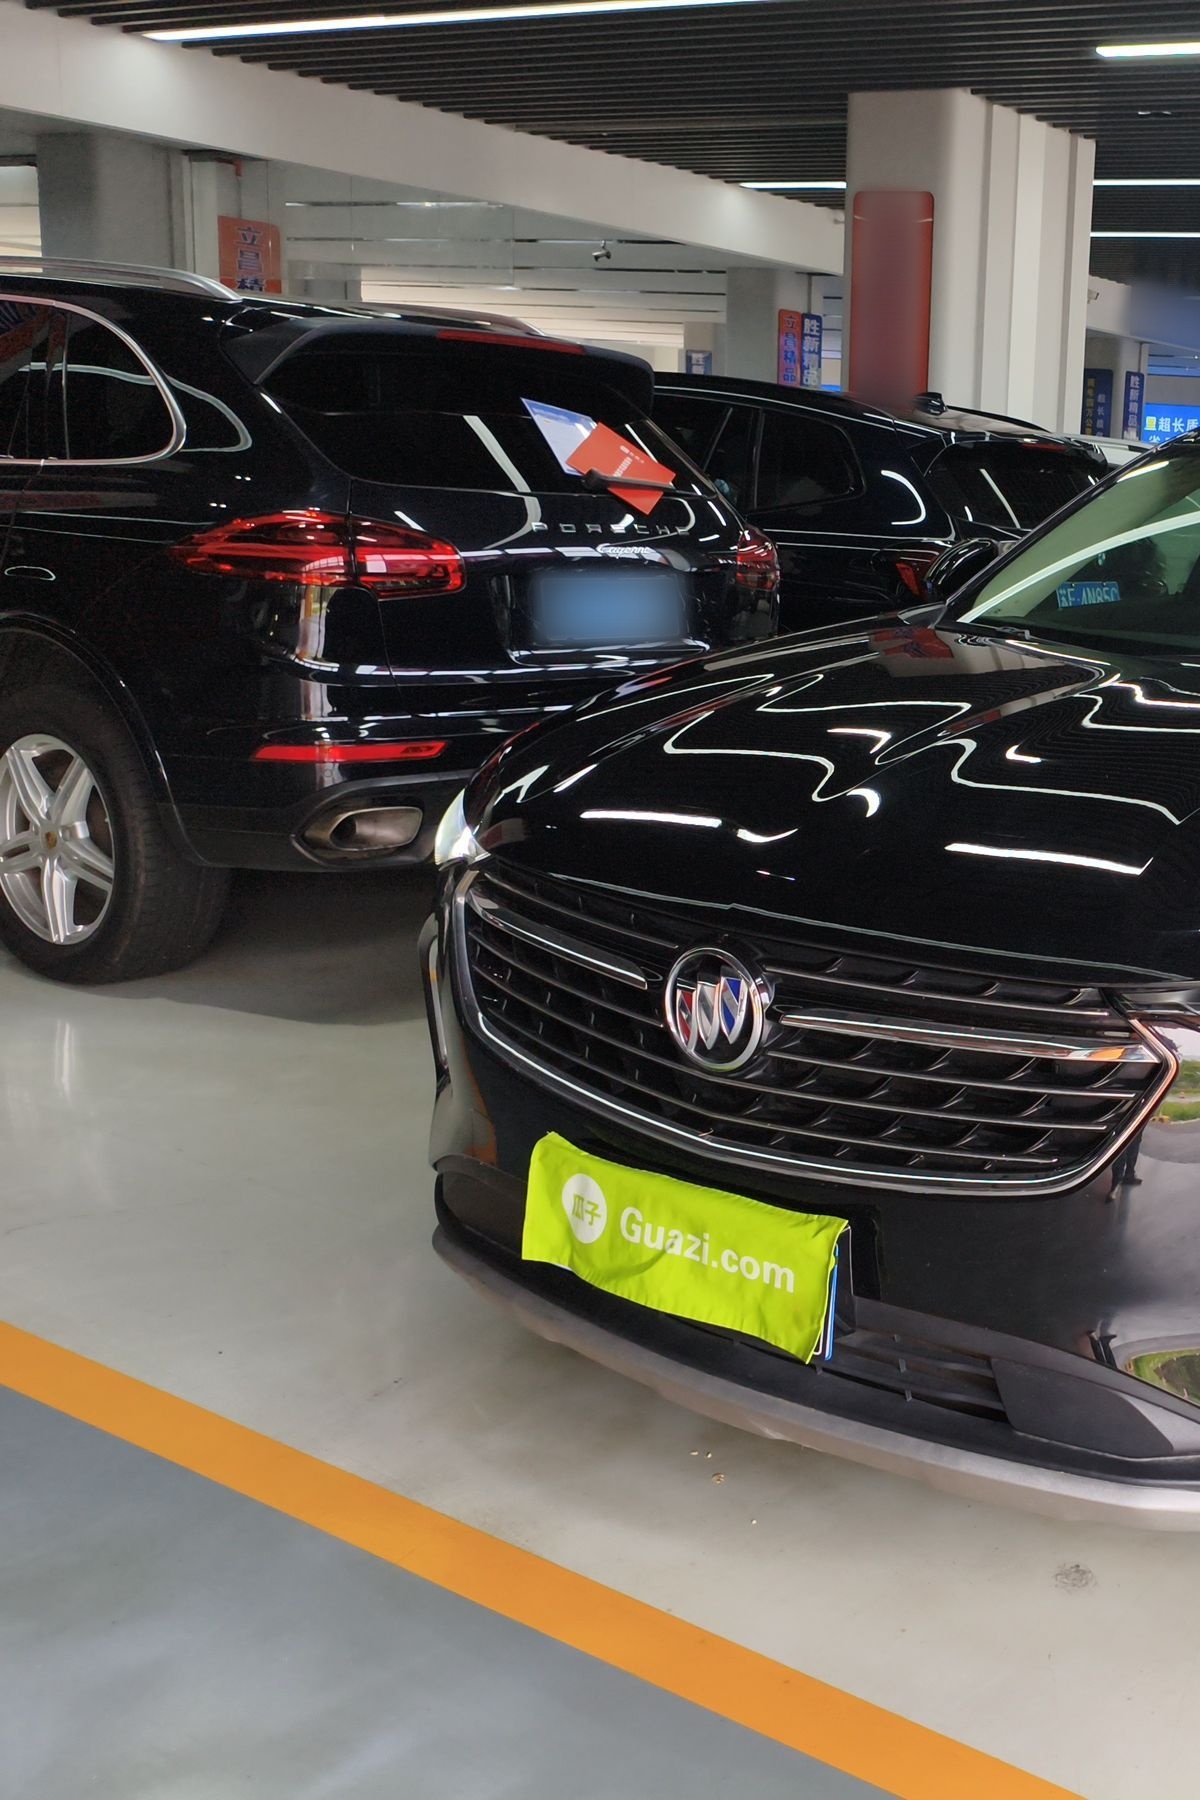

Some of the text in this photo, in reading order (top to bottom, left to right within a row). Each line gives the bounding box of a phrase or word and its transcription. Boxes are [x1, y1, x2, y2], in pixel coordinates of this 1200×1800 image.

[803, 317, 820, 386] 胜新精品
[531, 521, 690, 535] PORSCHE
[572, 1192, 601, 1226] 瓜子
[619, 1206, 796, 1294] Guazi.com
